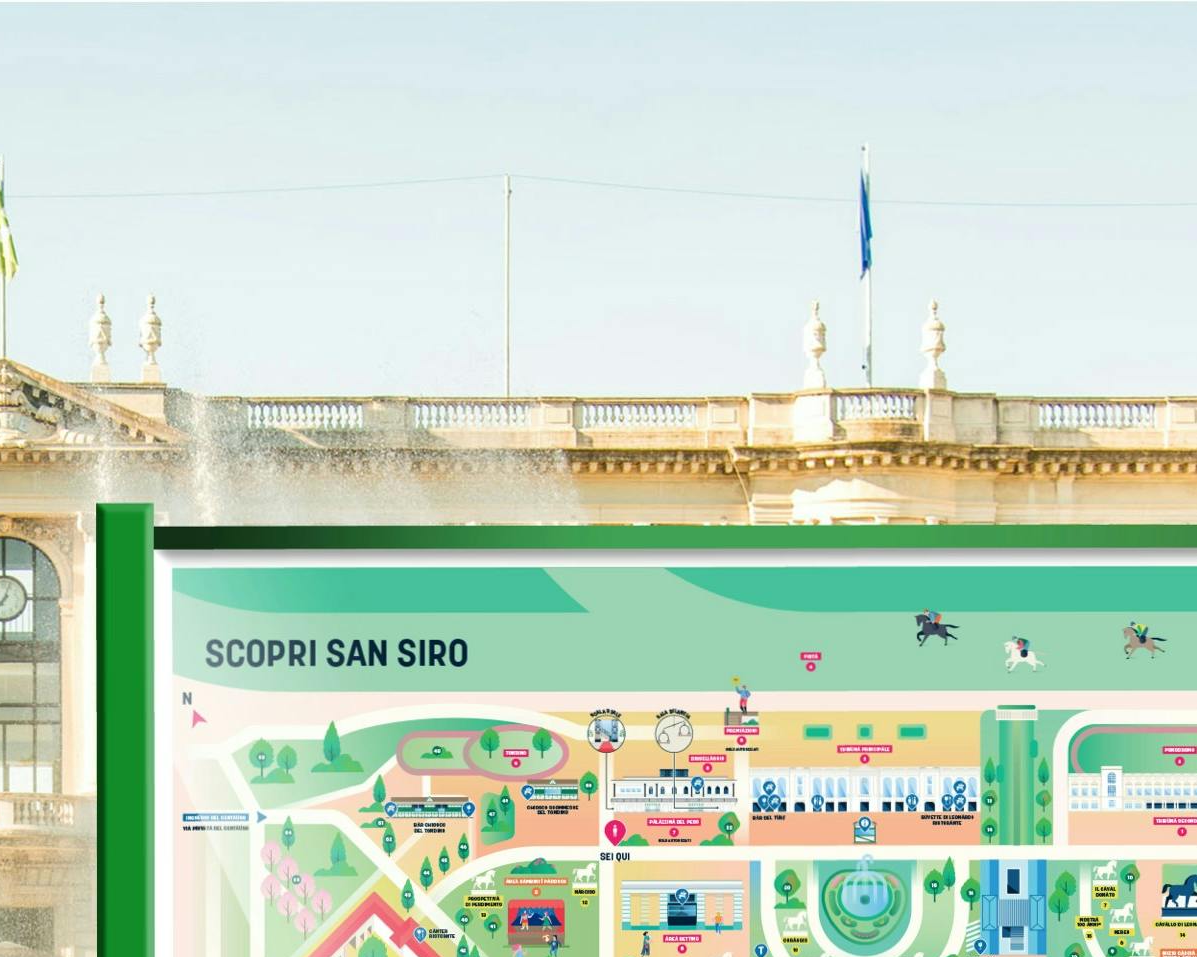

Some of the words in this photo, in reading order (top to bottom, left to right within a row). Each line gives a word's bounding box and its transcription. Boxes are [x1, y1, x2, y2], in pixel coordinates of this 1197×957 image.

[206, 638, 316, 668] SCOPRI
[326, 638, 387, 668] SAN
[398, 638, 468, 668] SIRO
[183, 693, 192, 704] N
[600, 852, 613, 861] SEI
[616, 852, 630, 861] QUI
